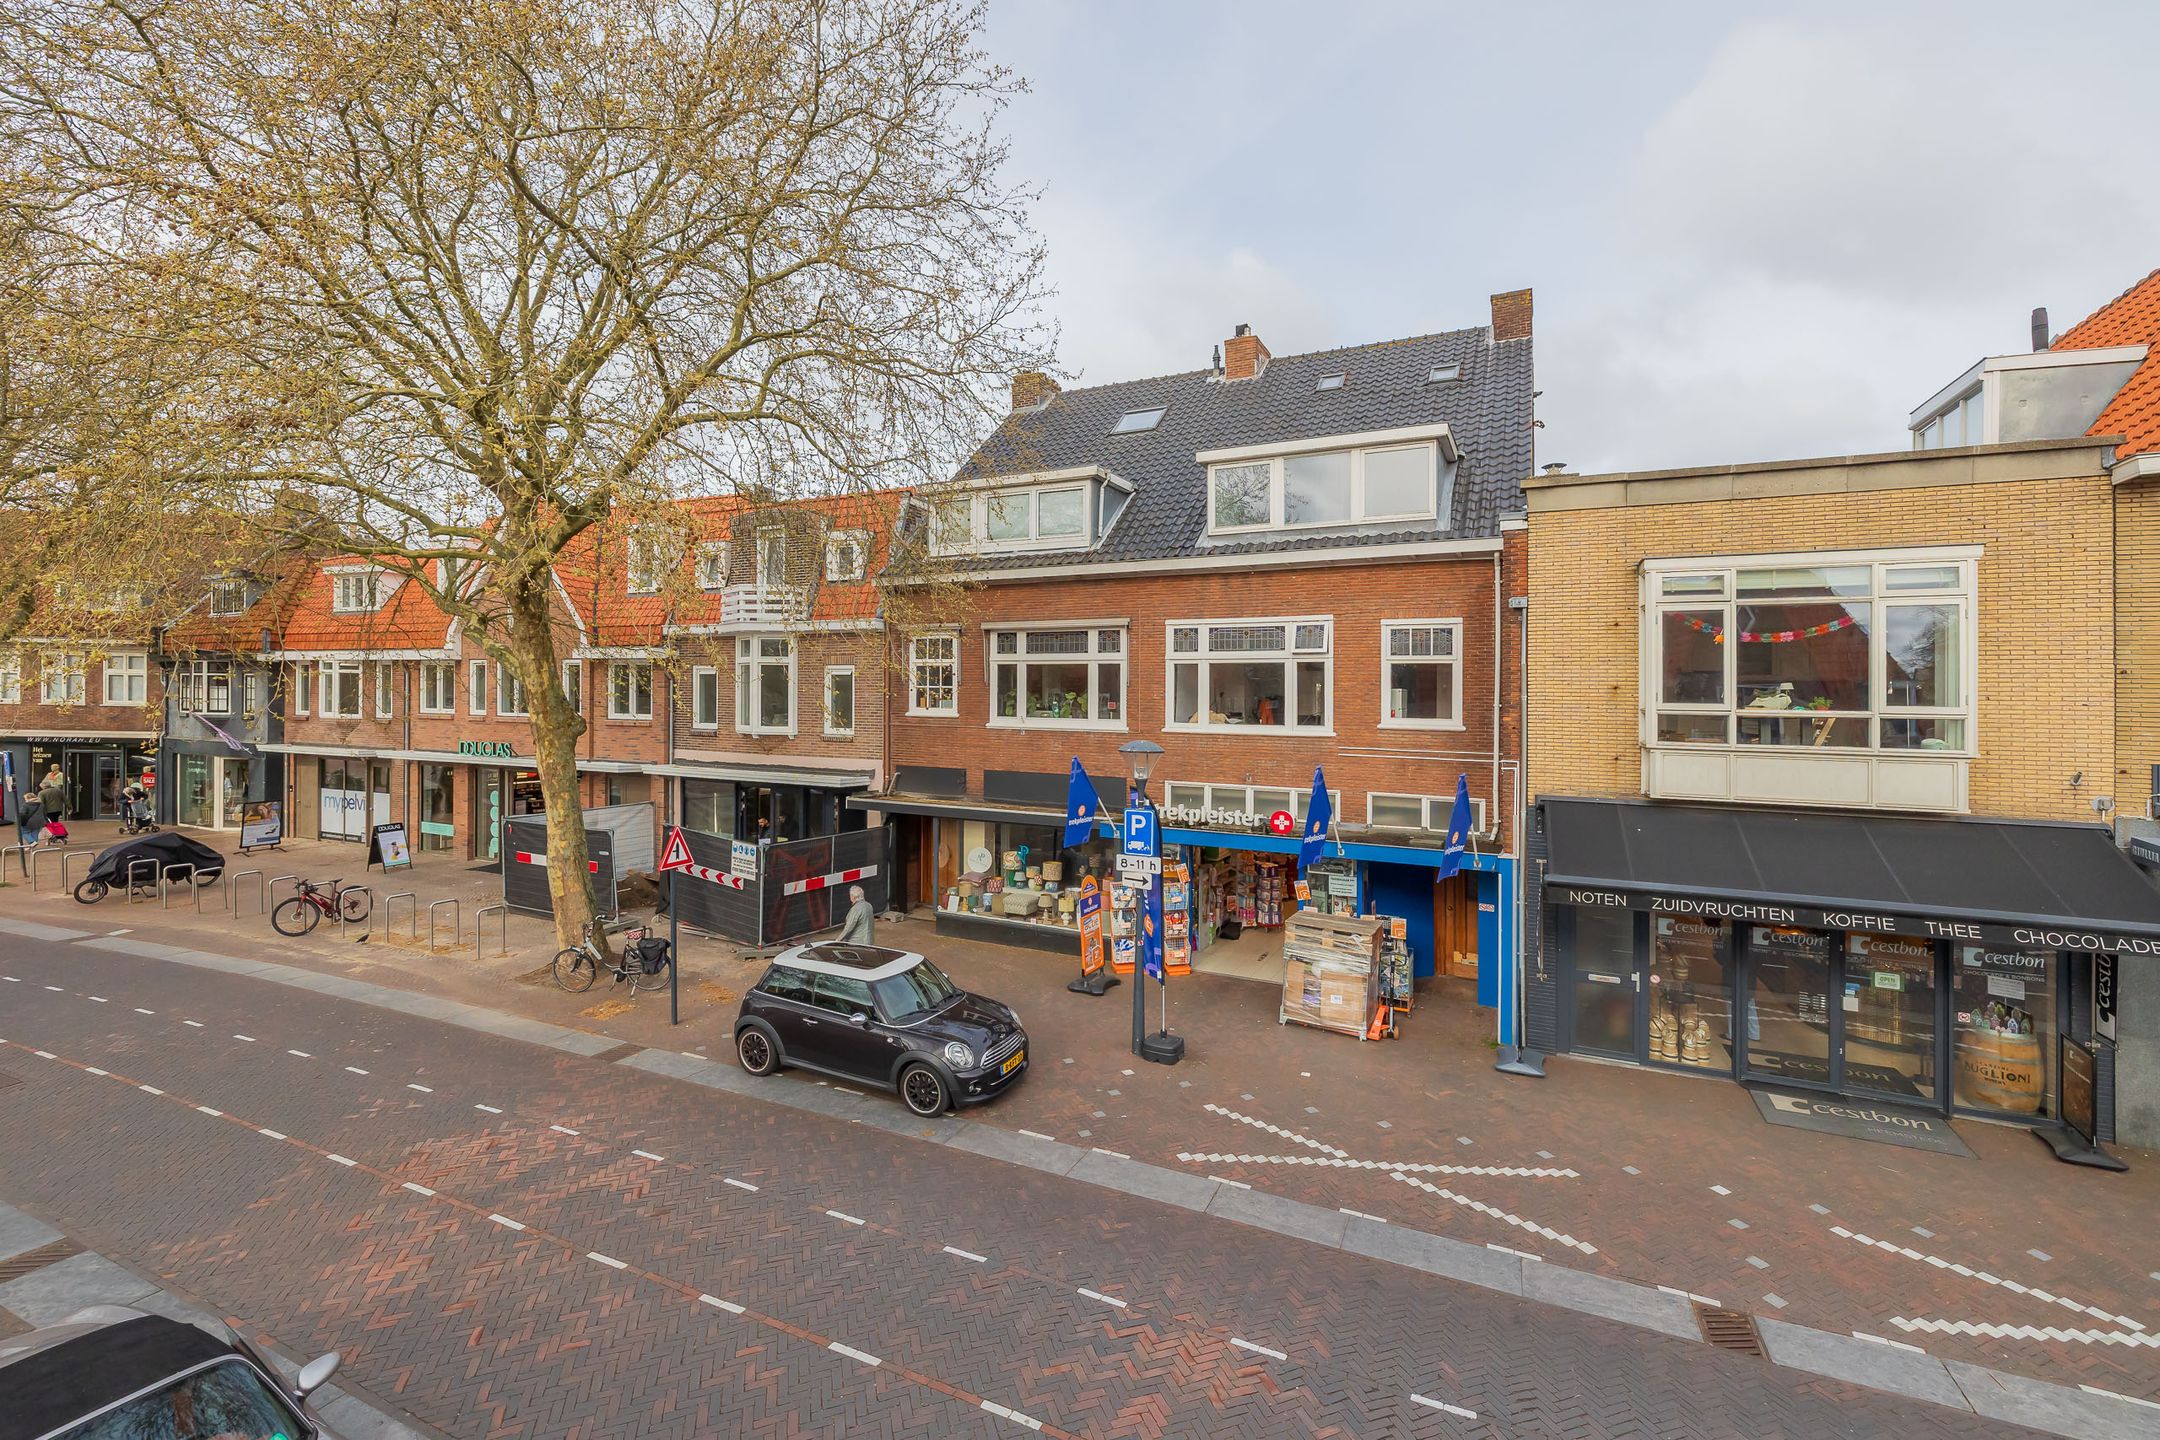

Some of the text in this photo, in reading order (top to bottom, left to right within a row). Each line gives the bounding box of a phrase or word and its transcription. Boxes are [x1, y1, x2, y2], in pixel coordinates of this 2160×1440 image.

[459, 740, 512, 758] DOUGLAS
[1131, 814, 1147, 836] P
[1149, 860, 1156, 871] h
[1569, 890, 1627, 907] NOTEN
[1652, 897, 1795, 922] ZUIDVRUCHTEN
[1823, 912, 1896, 931] KOFFIE
[1924, 921, 1983, 939] THEE
